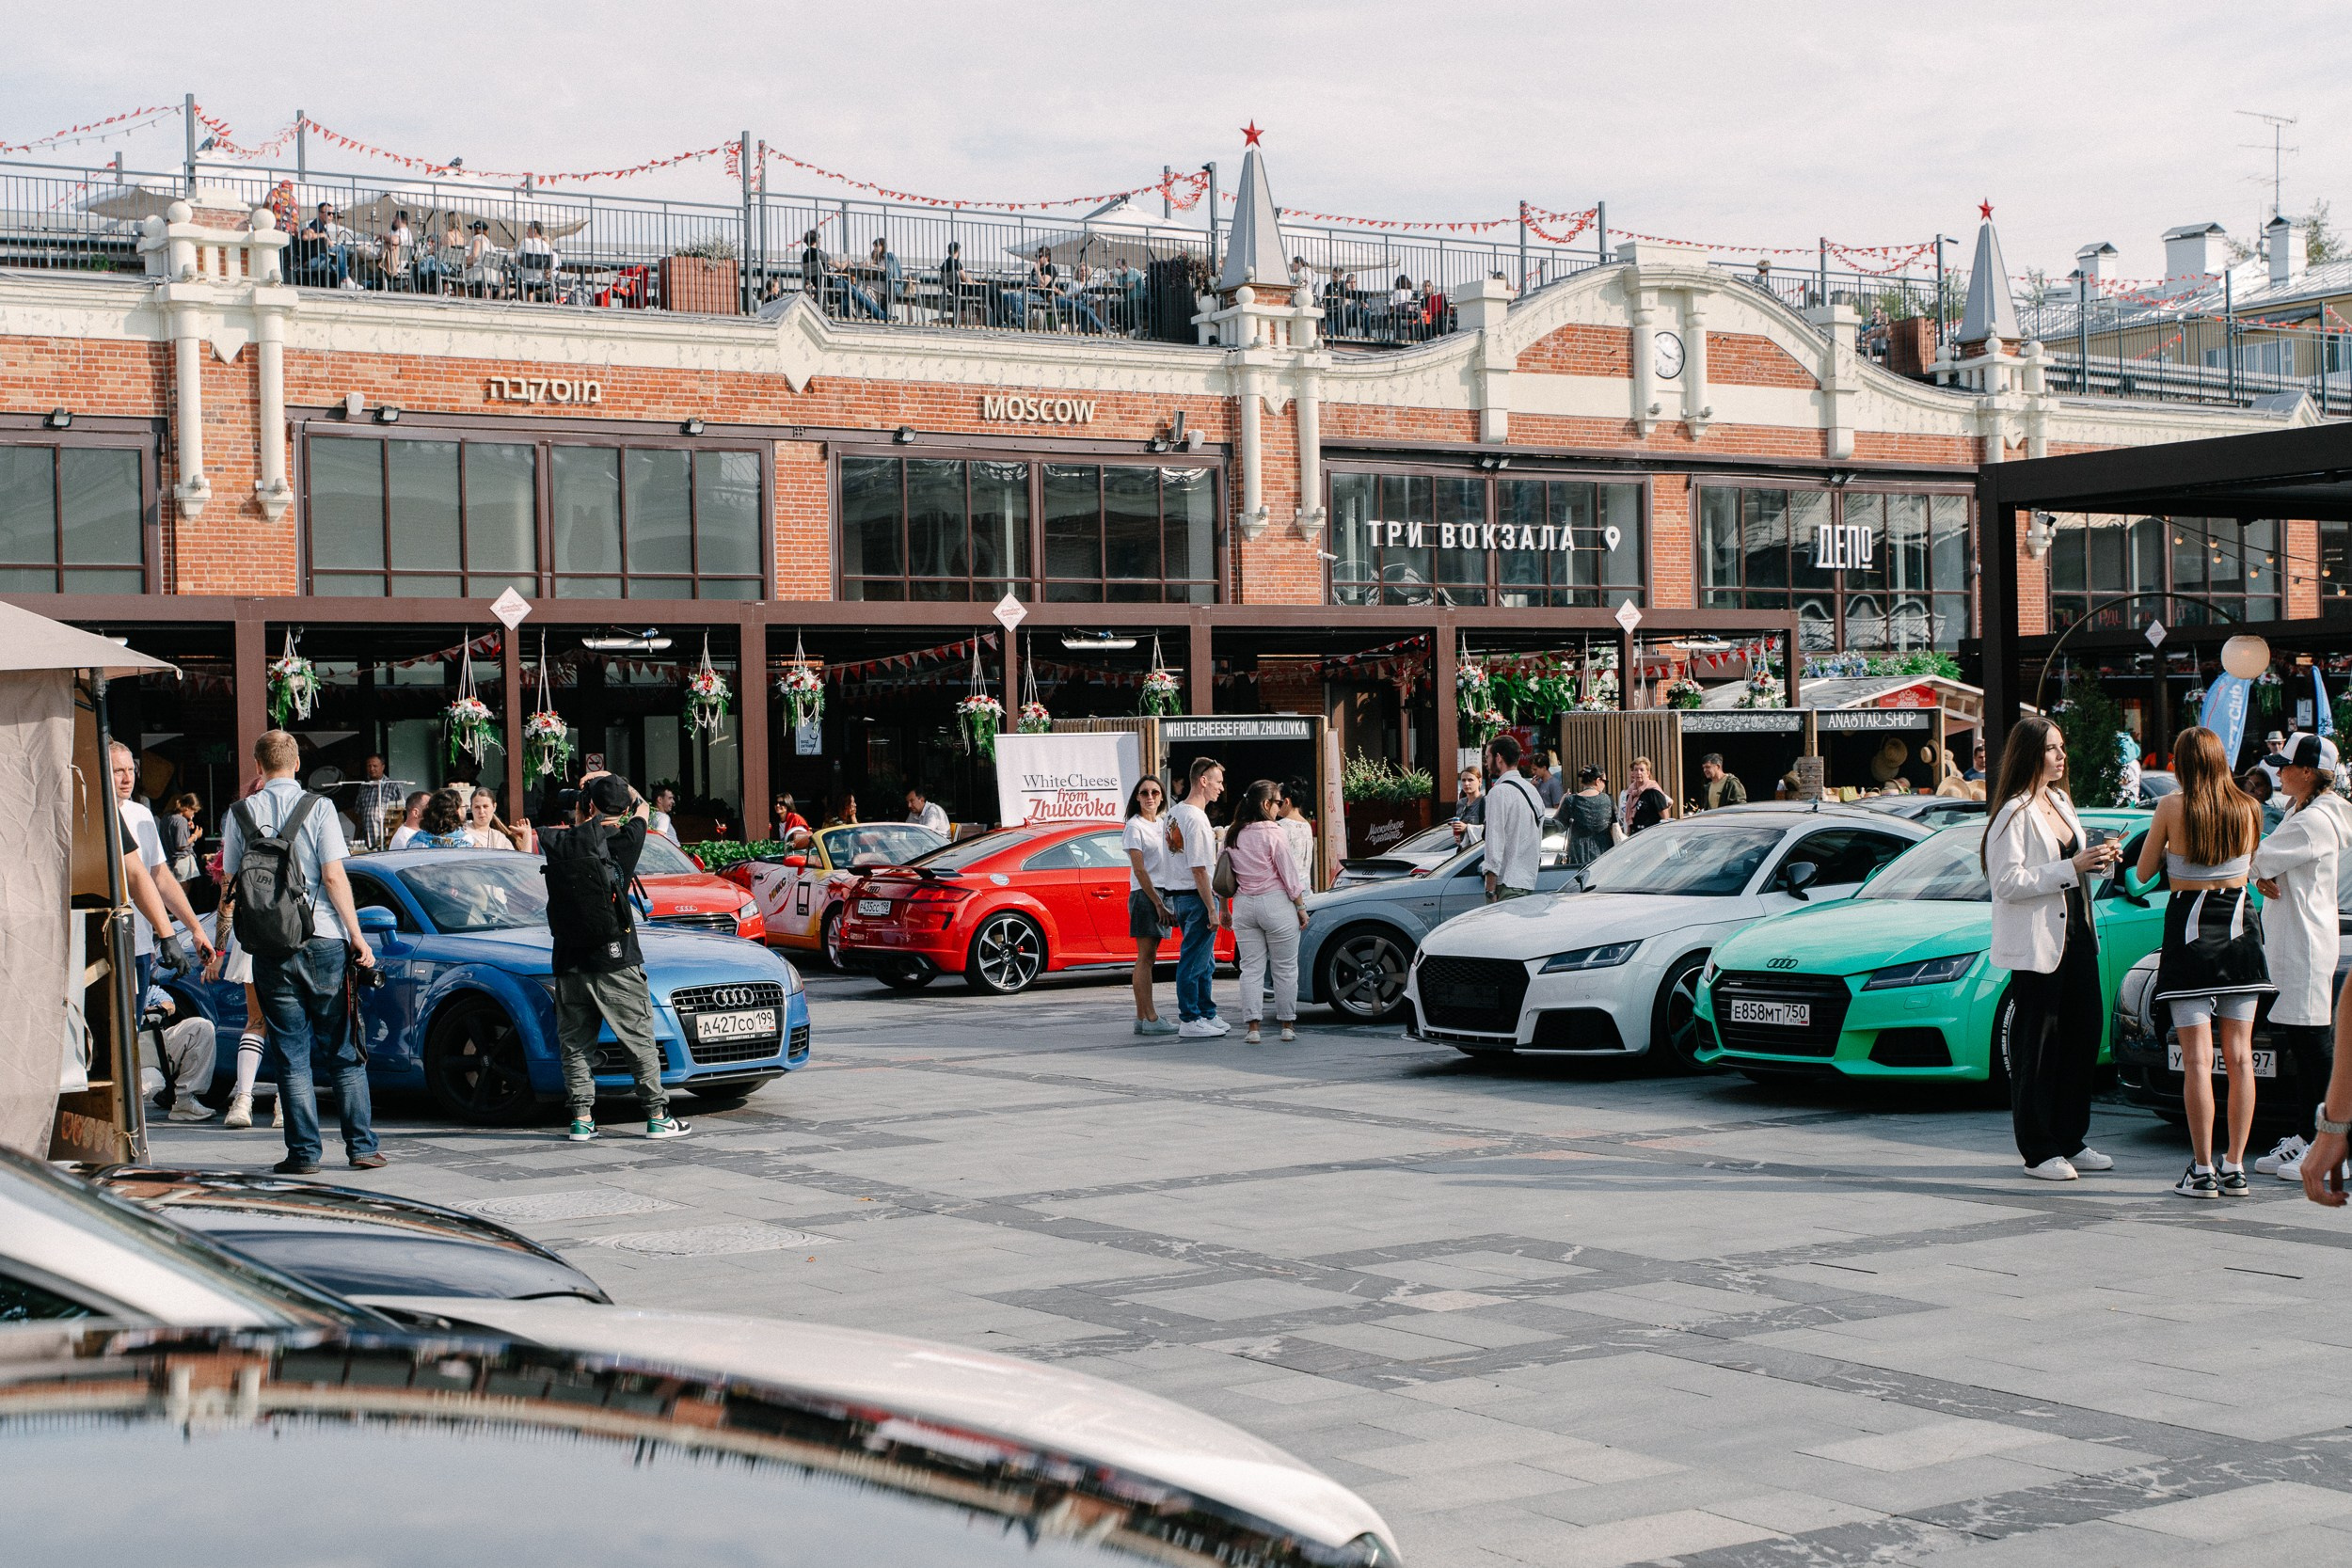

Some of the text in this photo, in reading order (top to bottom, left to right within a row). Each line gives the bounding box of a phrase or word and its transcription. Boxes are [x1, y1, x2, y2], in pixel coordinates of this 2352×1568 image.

[490, 376, 601, 403] מוסקבה
[984, 395, 1096, 422] MOSCOW
[1367, 520, 1575, 551] ТРИ ВОКЗАЛА
[1816, 524, 1873, 570] ДЕПО
[1260, 721, 1307, 736] ZHUKOVKA
[1057, 788, 1089, 804] from
[1027, 798, 1117, 821] Zhukovka
[703, 1011, 772, 1036] А427СО 199
[1735, 1003, 1806, 1022] Е858МТ 750
